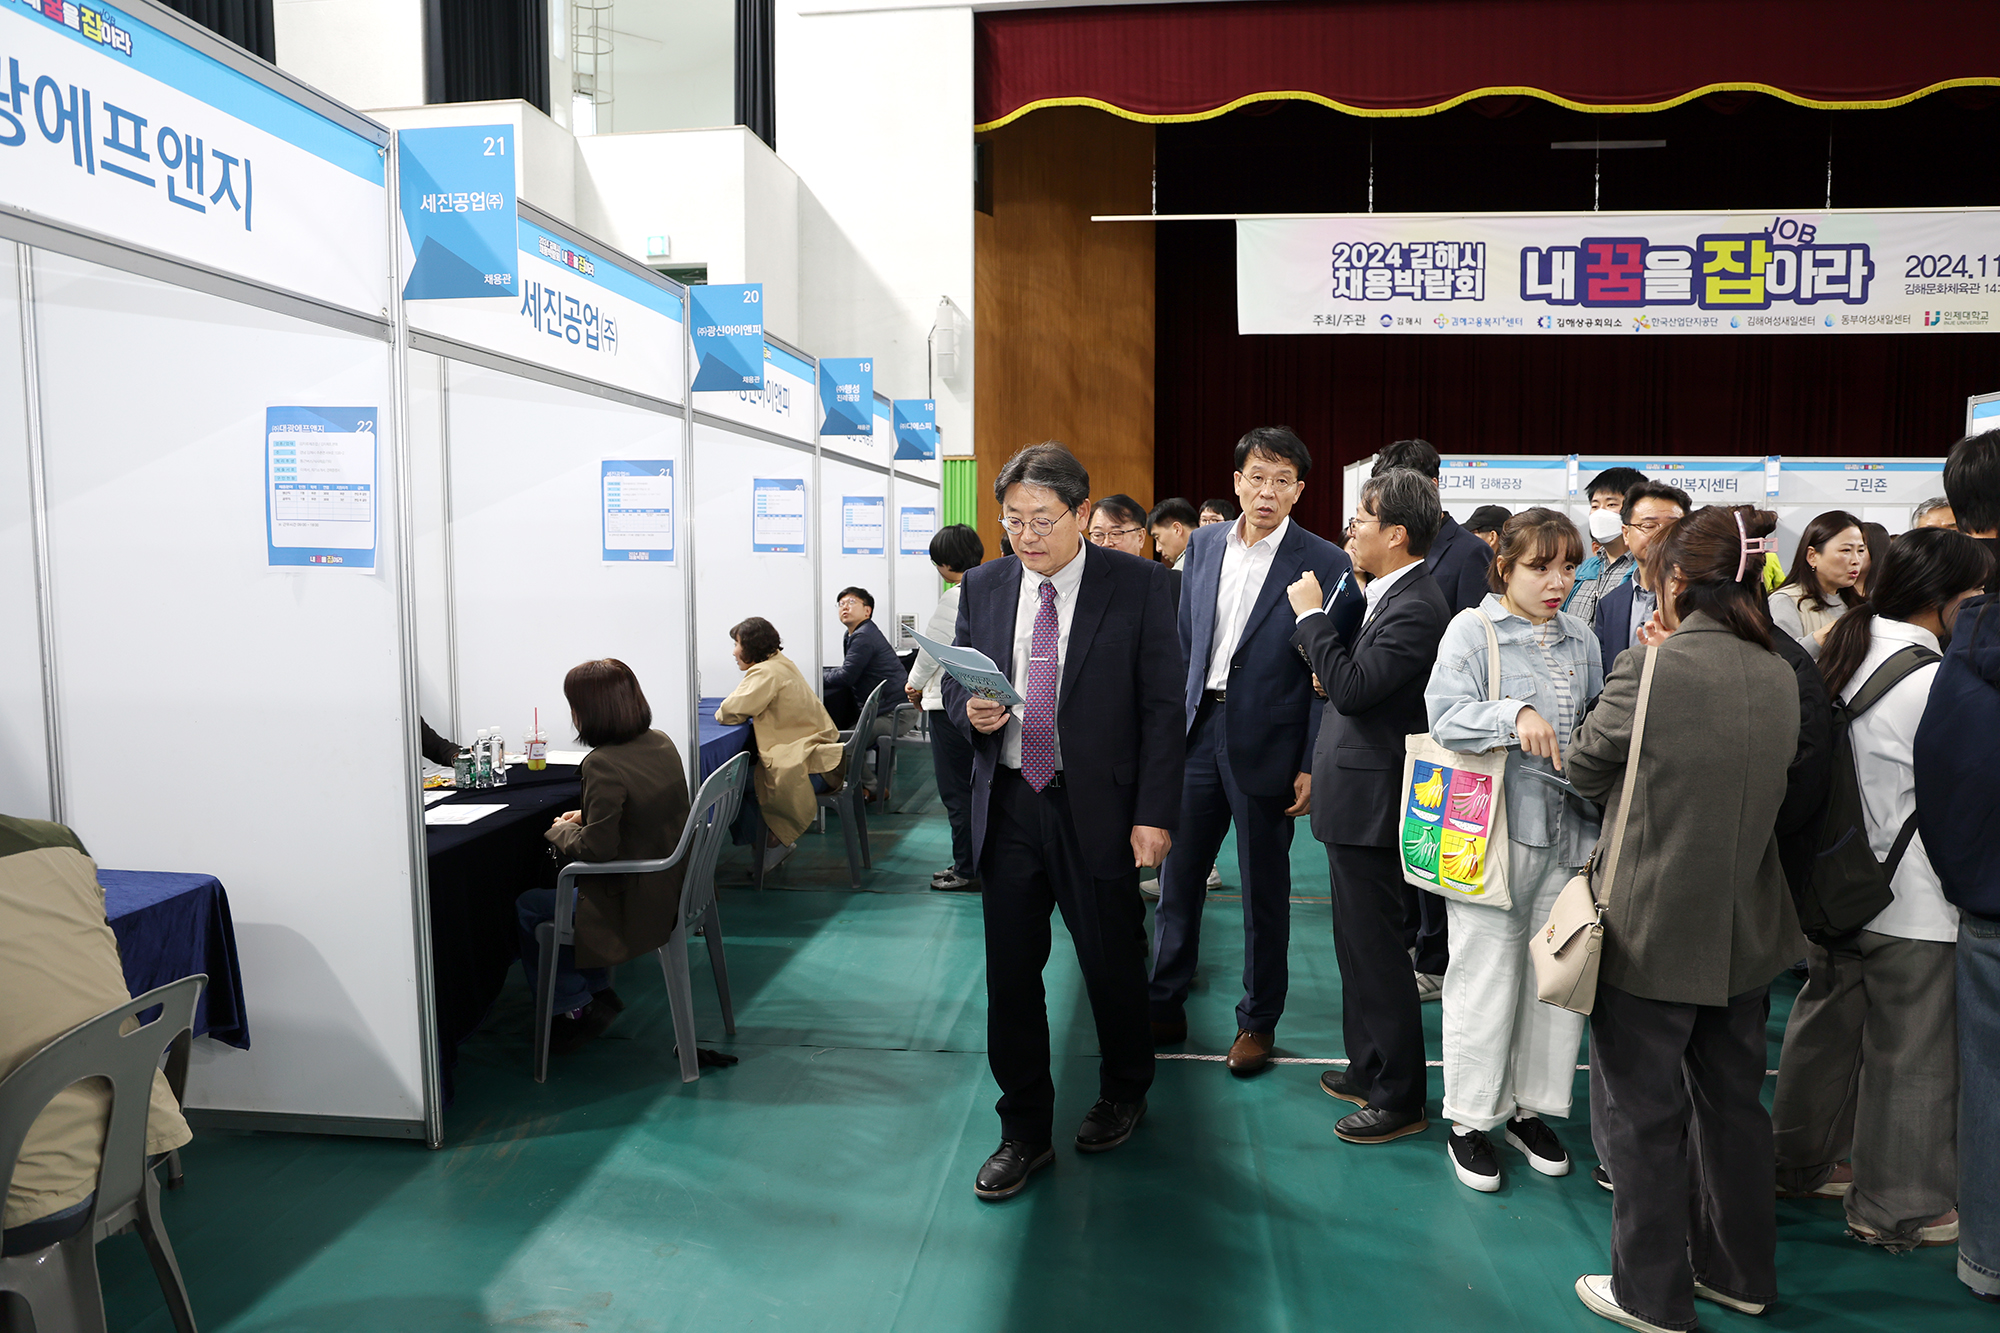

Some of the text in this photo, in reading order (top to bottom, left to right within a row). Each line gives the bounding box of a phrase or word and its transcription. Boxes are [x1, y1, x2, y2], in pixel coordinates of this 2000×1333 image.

[482, 136, 506, 157] 21
[1765, 216, 1817, 244] JOB
[1333, 241, 1486, 270] 2024 김해시
[1524, 249, 1577, 301] 내
[1586, 242, 1694, 302] 꿈을
[483, 273, 512, 285] 채용관
[1333, 267, 1485, 301] 채용박람회
[1904, 282, 1981, 295] 김해문화체육관
[742, 289, 760, 304] 20
[1312, 314, 1367, 328] 주최/주관
[1396, 316, 1422, 326] 김해시
[1556, 317, 1623, 328] 김해상공회의소
[1651, 316, 1719, 328] 한국산업단지공단
[1746, 315, 1816, 327] 김해여성새일센터
[1840, 314, 1911, 326] 동부여성새일센터
[1943, 311, 1989, 320] 인제대학교
[858, 362, 871, 373] 19
[742, 375, 760, 384] 채용관
[923, 402, 934, 411] 18
[355, 420, 373, 433] 22
[659, 468, 671, 477] 21
[1480, 477, 1522, 490] 김해공장
